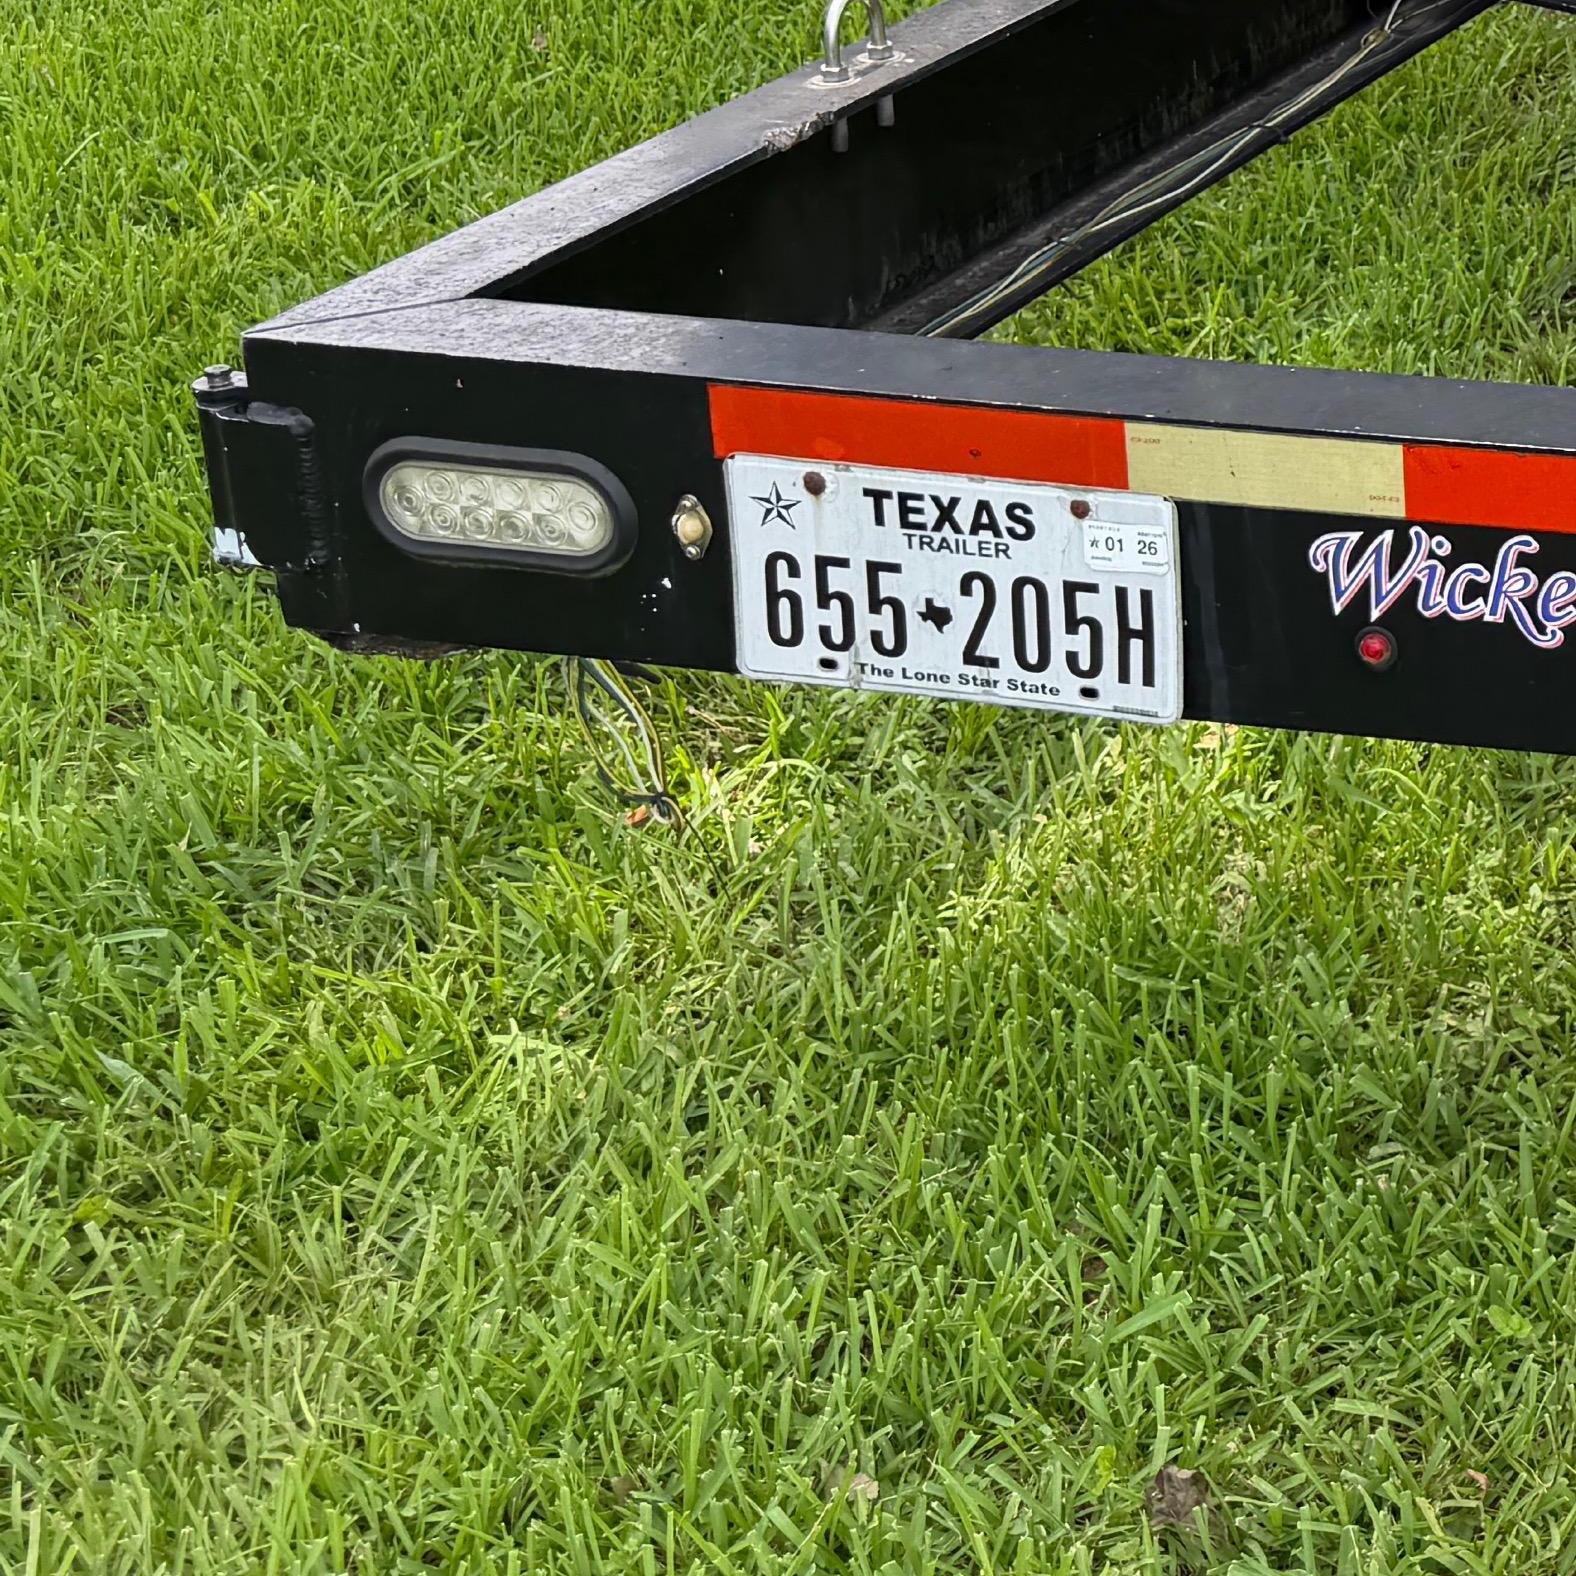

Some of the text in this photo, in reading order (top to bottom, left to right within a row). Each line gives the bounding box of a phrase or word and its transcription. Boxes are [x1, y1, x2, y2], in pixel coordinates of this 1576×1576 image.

[863, 487, 1036, 542] TEXAS
[902, 533, 1012, 560] TRAILER
[1104, 536, 1158, 556] 01 26
[765, 551, 1156, 688] 655 205H
[855, 662, 1061, 696] The Lone Star State
